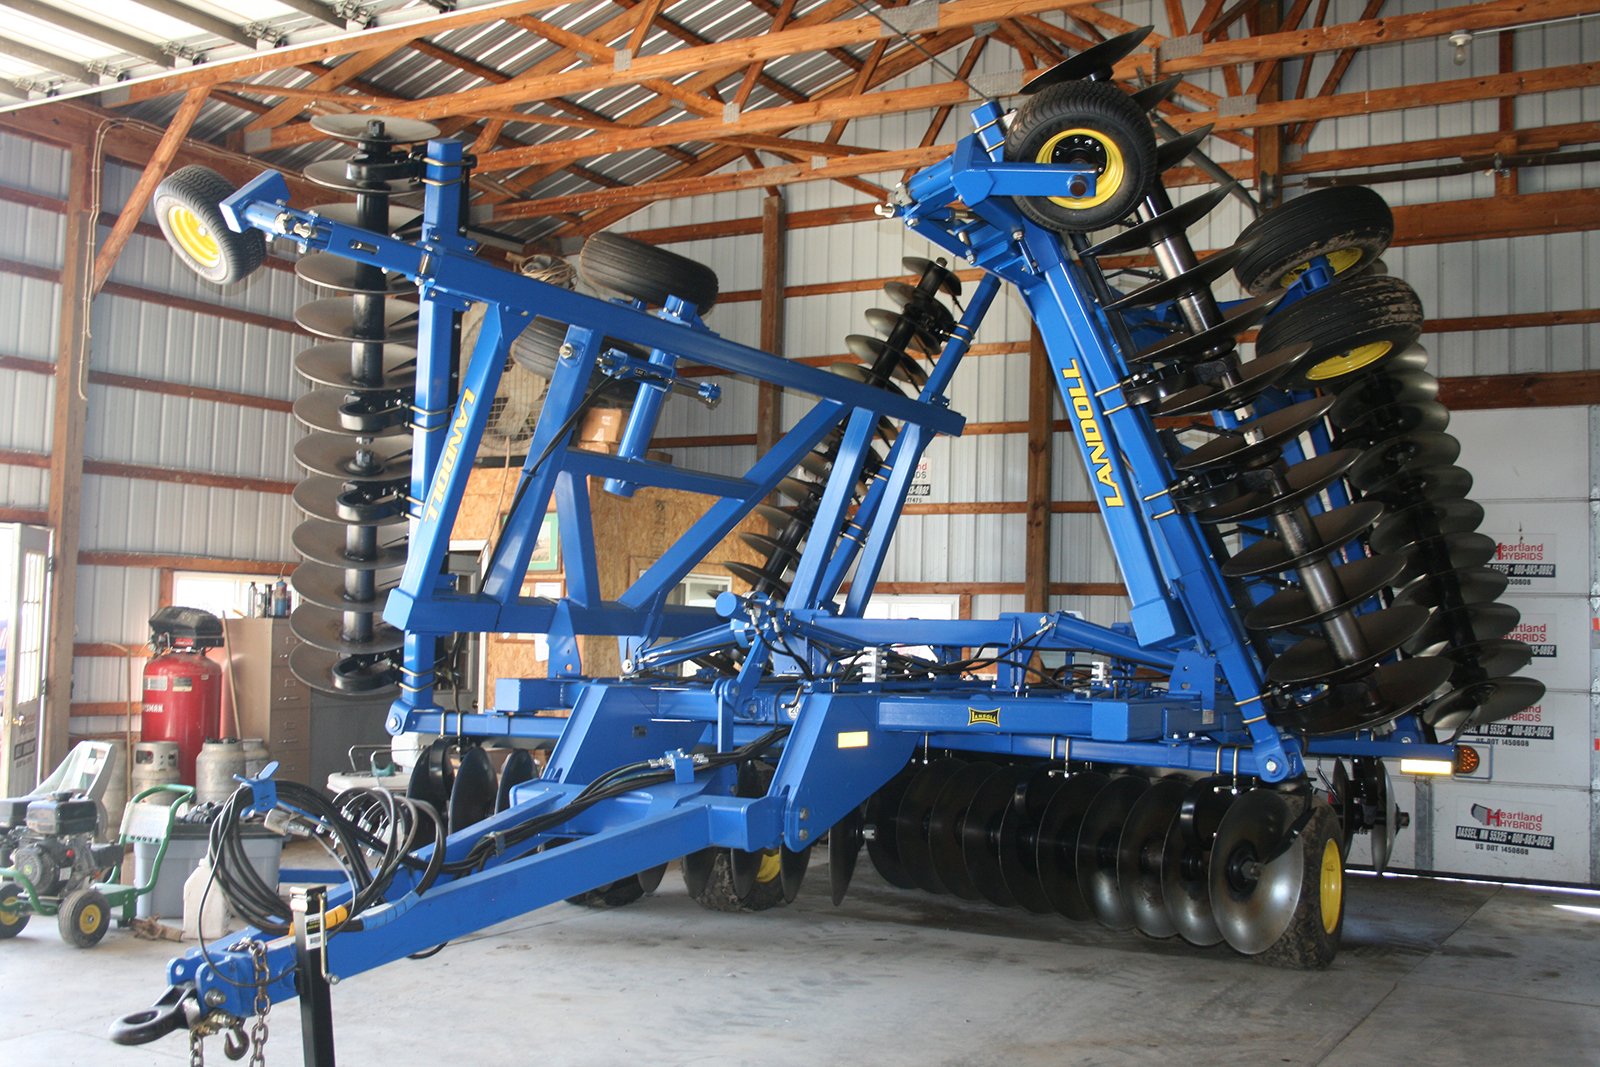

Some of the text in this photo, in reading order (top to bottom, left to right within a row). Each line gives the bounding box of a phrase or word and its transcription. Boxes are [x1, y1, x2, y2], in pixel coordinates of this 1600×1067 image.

[1061, 357, 1124, 507] LANDOLL
[425, 387, 476, 523] LANDOLL
[1502, 553, 1544, 561] HYBRIDS
[1513, 624, 1546, 633] rtland
[1487, 808, 1543, 827] Heartland
[1500, 820, 1542, 831] HYBRIDS
